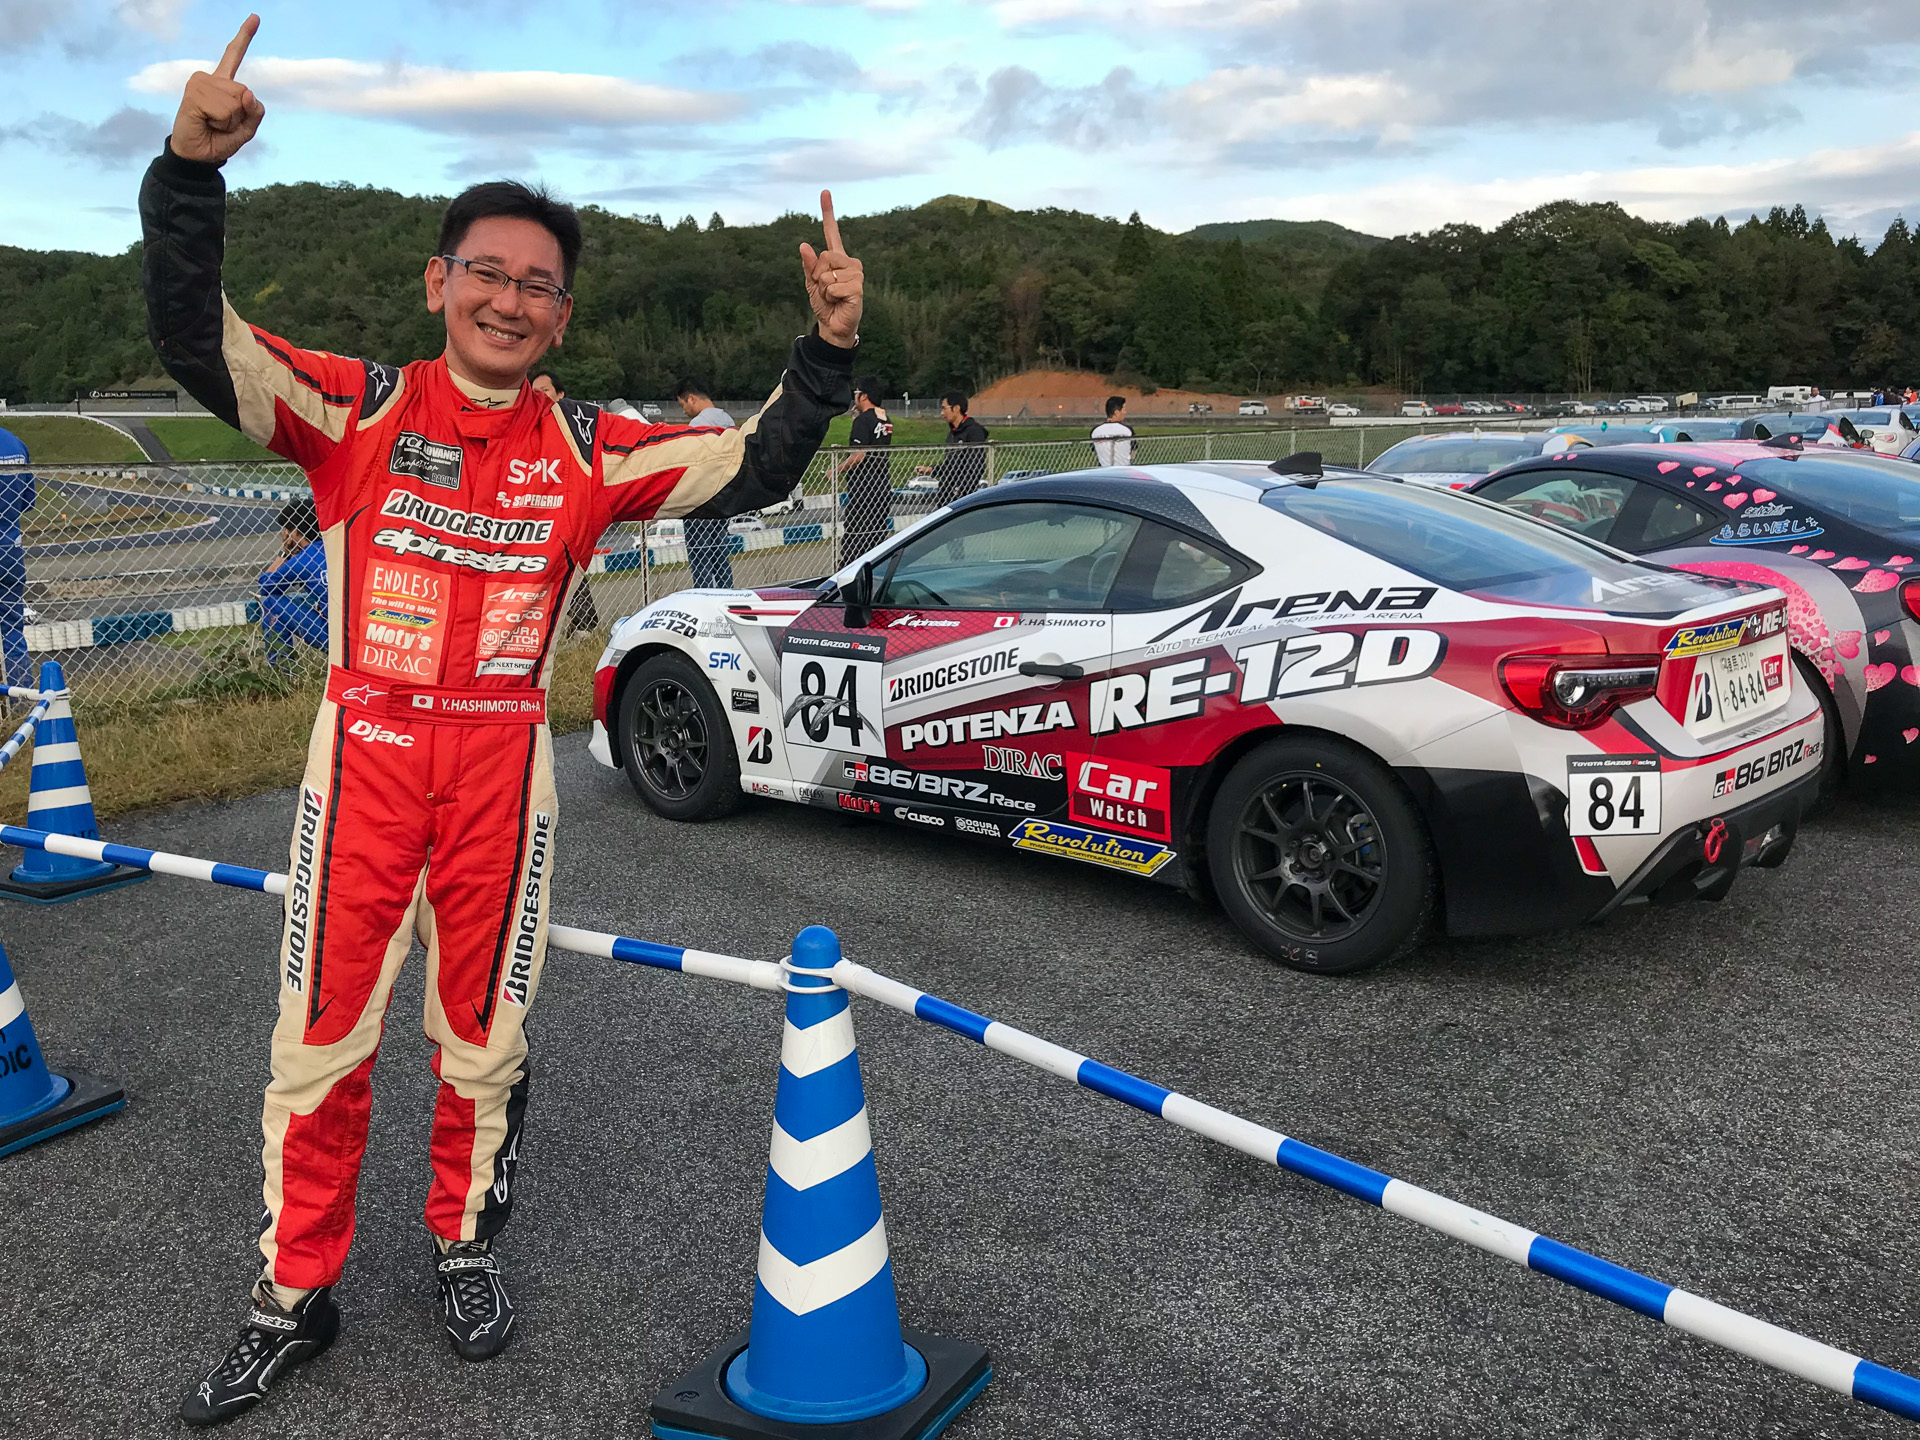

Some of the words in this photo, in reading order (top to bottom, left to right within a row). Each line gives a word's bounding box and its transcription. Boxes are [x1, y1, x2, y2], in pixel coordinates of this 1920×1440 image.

[385, 492, 552, 542] BRIDGESTONE
[374, 528, 548, 573] alpinestars
[373, 567, 438, 600] ENDLESS
[371, 596, 387, 605] The
[388, 601, 404, 609] will
[417, 606, 437, 615] WIN.
[650, 610, 698, 625] POTENZA
[366, 623, 433, 651] Moty's
[1017, 619, 1106, 627] Y.HASHIMOTO
[1146, 641, 1182, 657] AUTO
[1190, 624, 1266, 646] TECHNICAL
[1276, 614, 1355, 625] PROSHOP
[1678, 625, 1738, 647] Revolution
[362, 645, 432, 676] DIRAC
[788, 636, 819, 646] TOYOTA
[820, 639, 850, 649] GAZOO
[852, 642, 880, 654] Racing
[709, 652, 741, 670] SPK
[890, 647, 1019, 702] BRIDGESTONE
[1763, 661, 1779, 677] Car
[1090, 628, 1447, 736] RE-12D
[441, 698, 518, 712] Y.HASHIMOTO
[520, 699, 541, 712] Rh+A
[801, 661, 864, 747] 84
[348, 720, 415, 747] Djac
[901, 700, 1077, 751] POTENZA
[982, 745, 1063, 781] DIRAC
[1632, 759, 1656, 767] Racing
[869, 765, 989, 804] 86/BRZ
[990, 793, 1036, 811] Race
[1079, 761, 1158, 803] Car
[838, 793, 880, 814] Moty's
[1090, 798, 1147, 828] Watch
[1588, 775, 1645, 831] 84
[966, 819, 999, 831] OGURA
[966, 826, 1001, 838] CLUTCH
[1024, 822, 1145, 862] Revolution
[286, 786, 323, 993] BRIDGESTONE
[503, 814, 551, 1007] BRIDGESTONE
